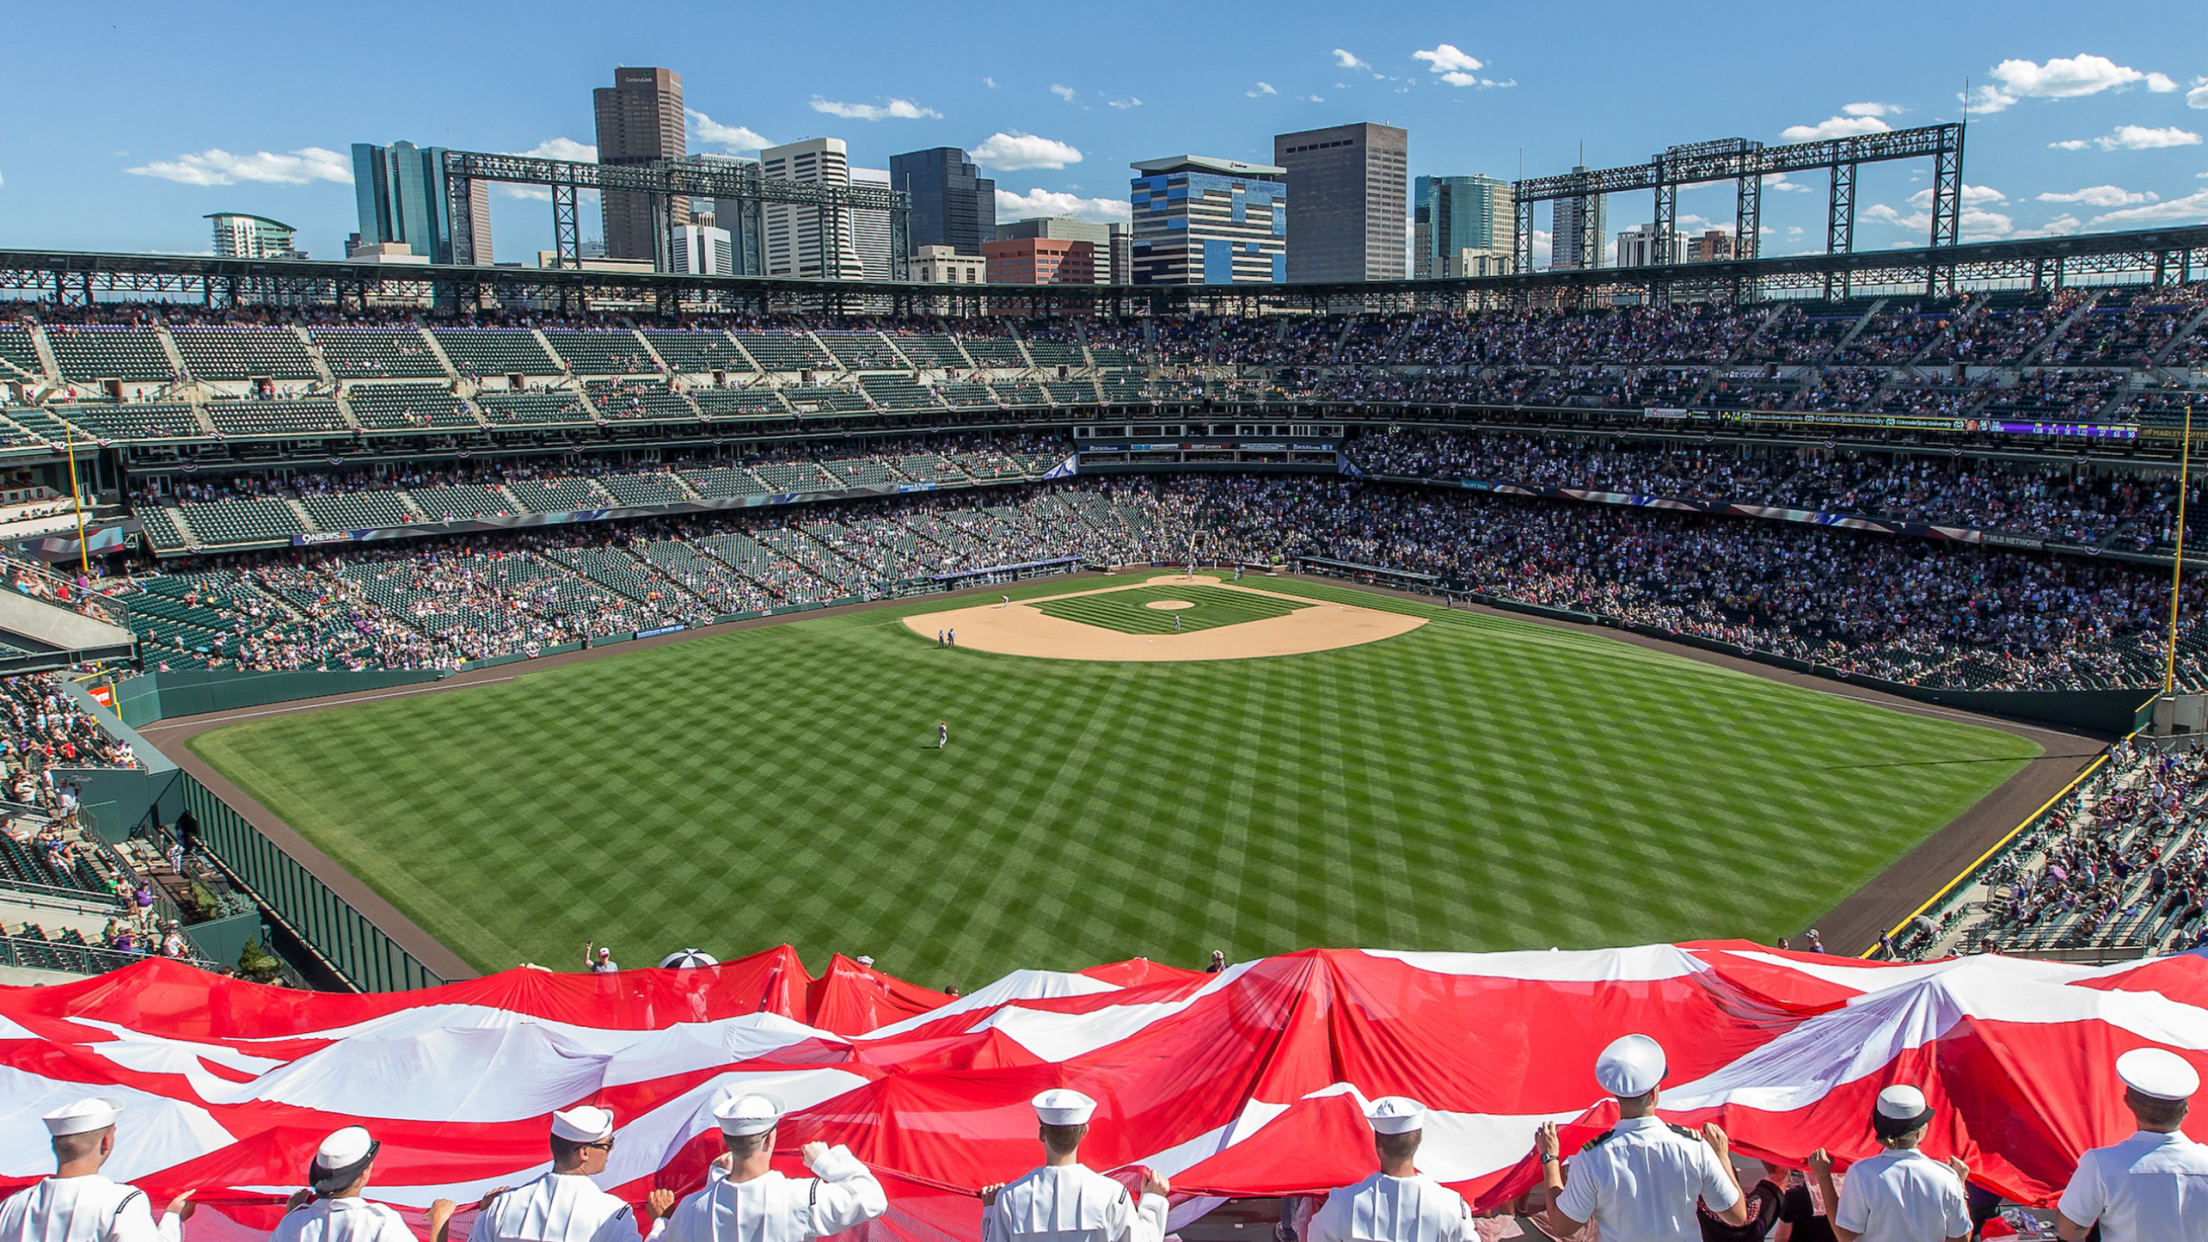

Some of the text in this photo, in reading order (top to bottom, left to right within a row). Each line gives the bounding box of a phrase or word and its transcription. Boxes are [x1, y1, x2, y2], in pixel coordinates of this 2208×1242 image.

[1855, 416, 1885, 427] University
[302, 531, 340, 545] 9NEWS
[1989, 534, 2042, 547] MLB NETWORK
